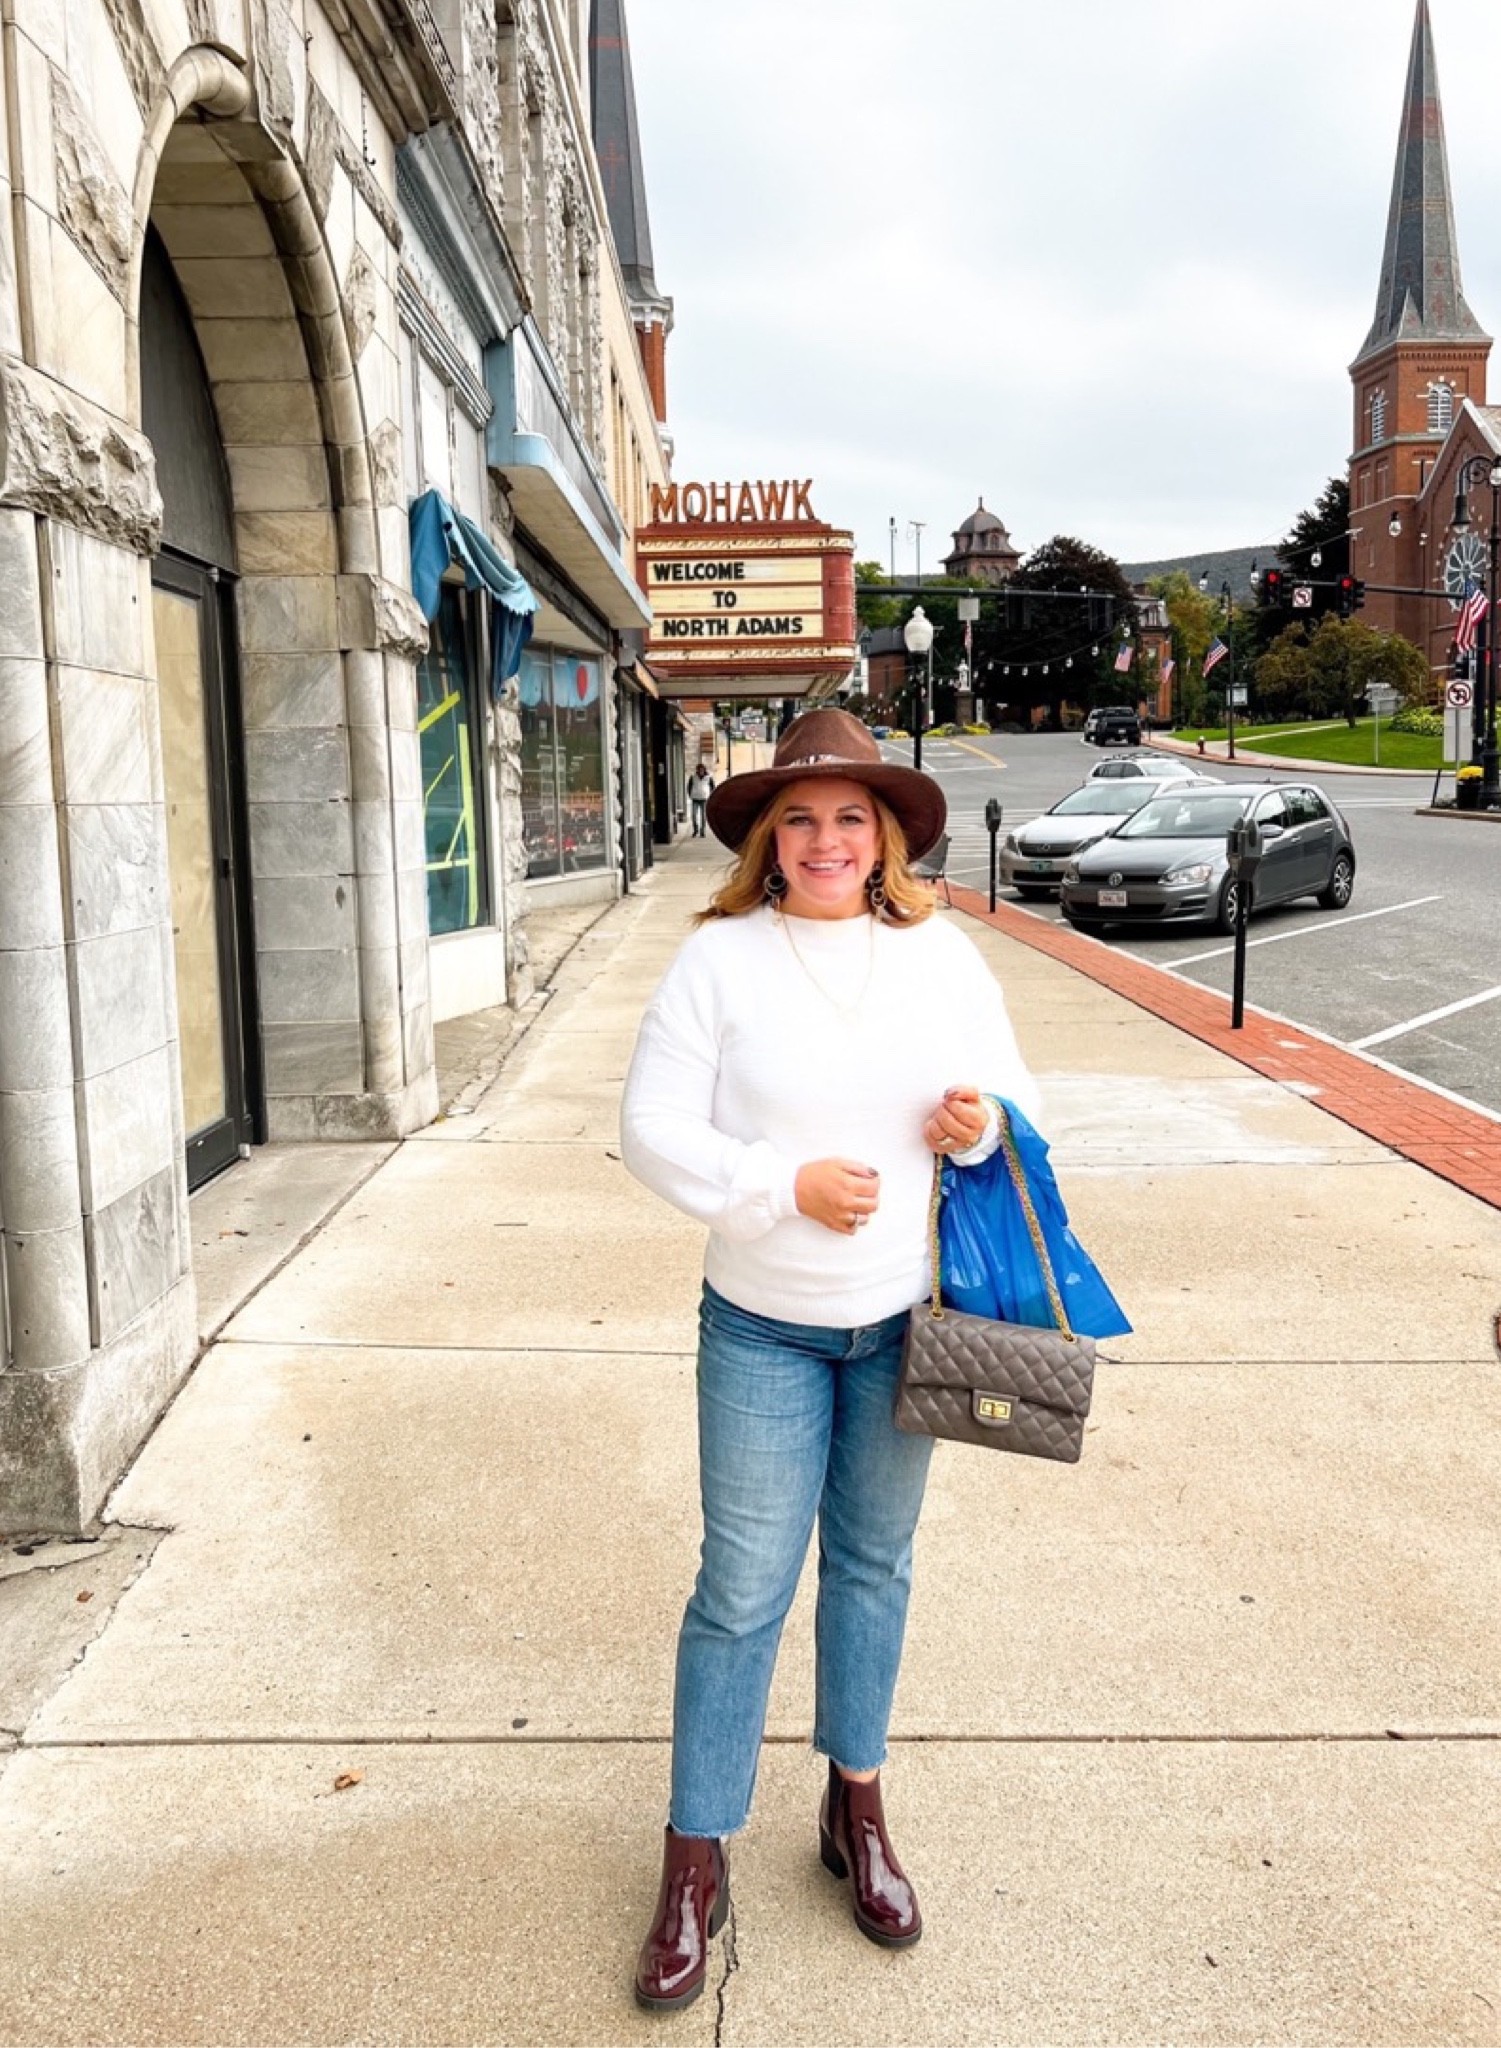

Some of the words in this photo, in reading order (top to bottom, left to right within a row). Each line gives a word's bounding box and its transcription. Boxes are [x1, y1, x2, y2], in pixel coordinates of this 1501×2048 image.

[650, 478, 815, 523] MOHAWK
[653, 561, 745, 582] WELCOME
[712, 590, 737, 608] TO
[662, 618, 729, 637] NORTH
[735, 616, 803, 636] ADAMS
